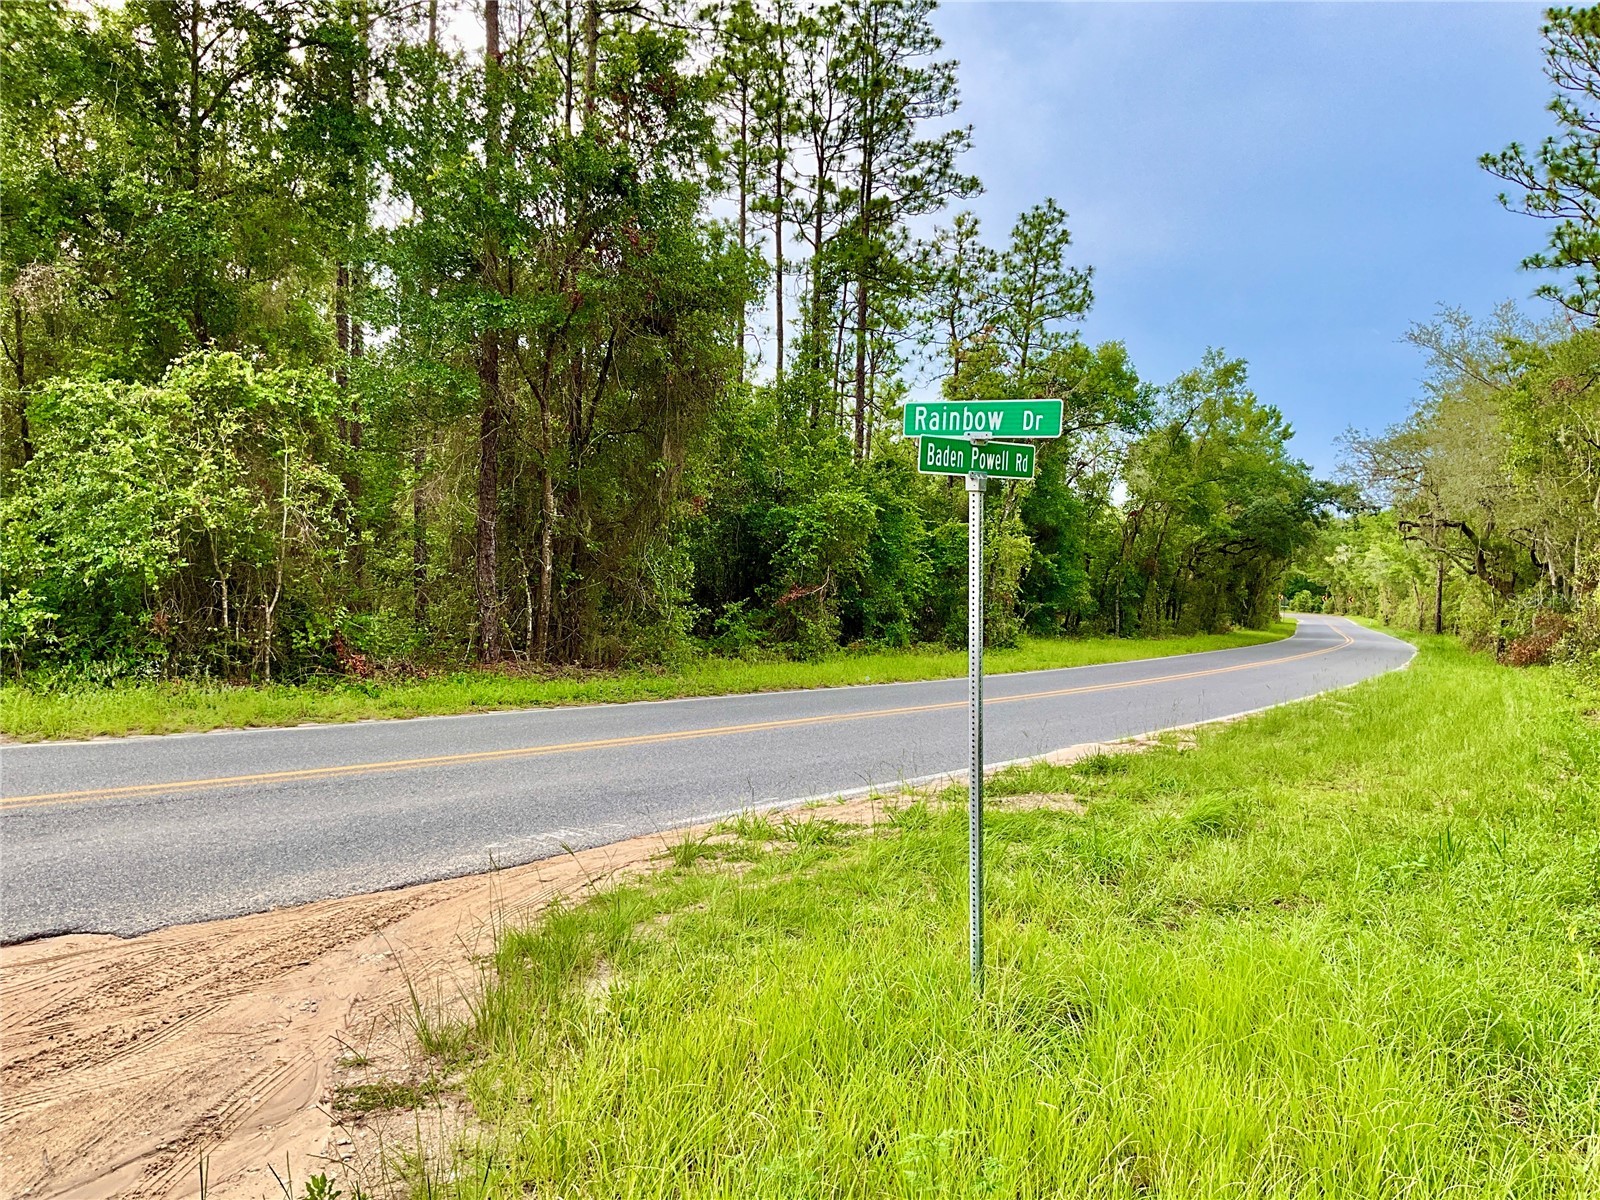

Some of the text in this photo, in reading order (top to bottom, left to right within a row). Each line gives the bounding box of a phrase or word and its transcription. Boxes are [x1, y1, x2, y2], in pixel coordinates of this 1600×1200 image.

[914, 406, 1044, 431] Rainbow Dr
[926, 443, 1029, 473] Baden Powell Rd
